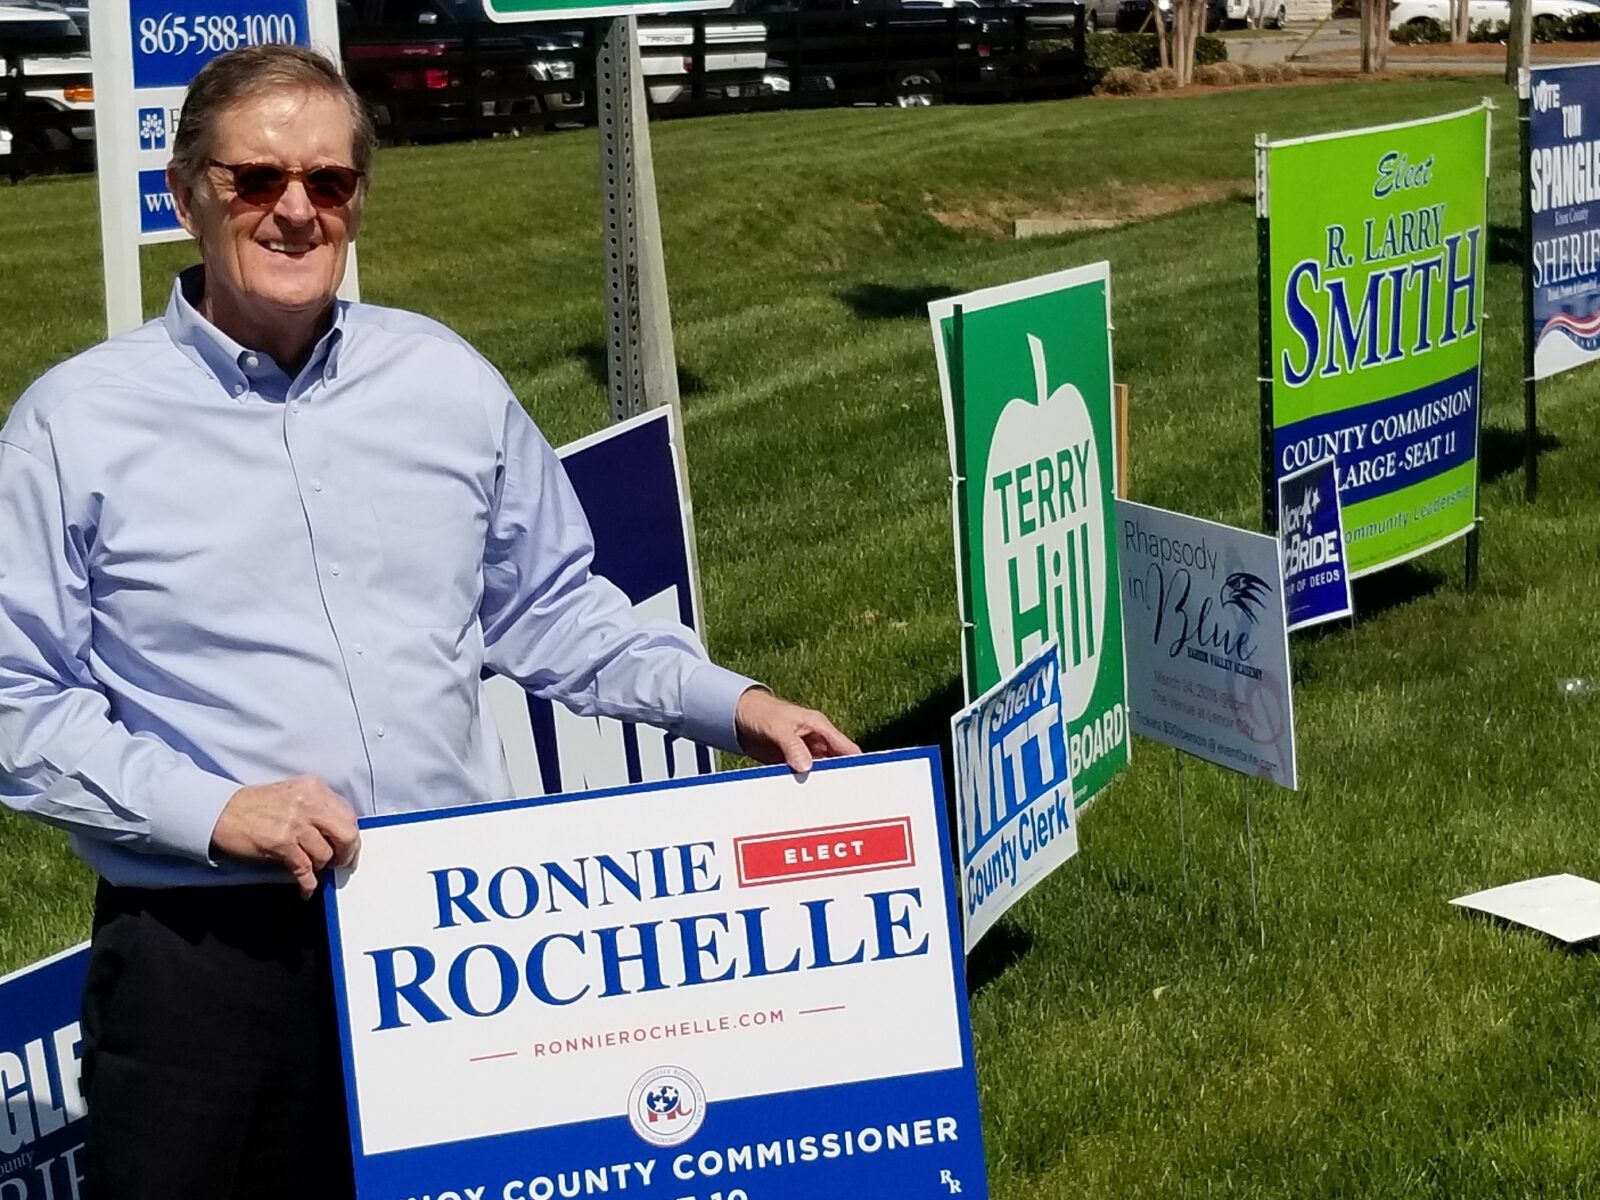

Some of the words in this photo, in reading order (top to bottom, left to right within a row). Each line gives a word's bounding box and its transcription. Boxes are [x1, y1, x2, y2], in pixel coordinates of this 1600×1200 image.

[139, 12, 296, 55] 865-588-1000
[1532, 80, 1560, 113] VOTE
[1562, 105, 1582, 138] TOM
[1373, 150, 1434, 199] Elect
[1325, 224, 1354, 271] R.
[1362, 203, 1447, 264] LARRY
[1282, 225, 1481, 388] SMITH
[1282, 423, 1368, 471] COUNTY
[1371, 386, 1473, 445] COMMISSION
[992, 439, 1091, 544] TERRY
[1124, 520, 1217, 580] Rhapsody
[1310, 569, 1340, 588] DEEDS
[1008, 522, 1095, 674] Hill
[1127, 569, 1145, 601] in
[1146, 563, 1258, 661] Blue
[992, 660, 1055, 732] Sherry
[957, 702, 1060, 854] WITT
[1070, 703, 1123, 780] BOARD
[427, 841, 721, 929] RONNIE
[784, 840, 865, 865] ELECT
[968, 833, 1017, 916] County
[1019, 789, 1070, 861] Clerk
[363, 887, 930, 1032] ROCHELLE
[534, 1009, 785, 1056] RONNIEROCHELLE.COM
[503, 1159, 657, 1200] COUNTY
[672, 1116, 958, 1180] COMMISSIONER
